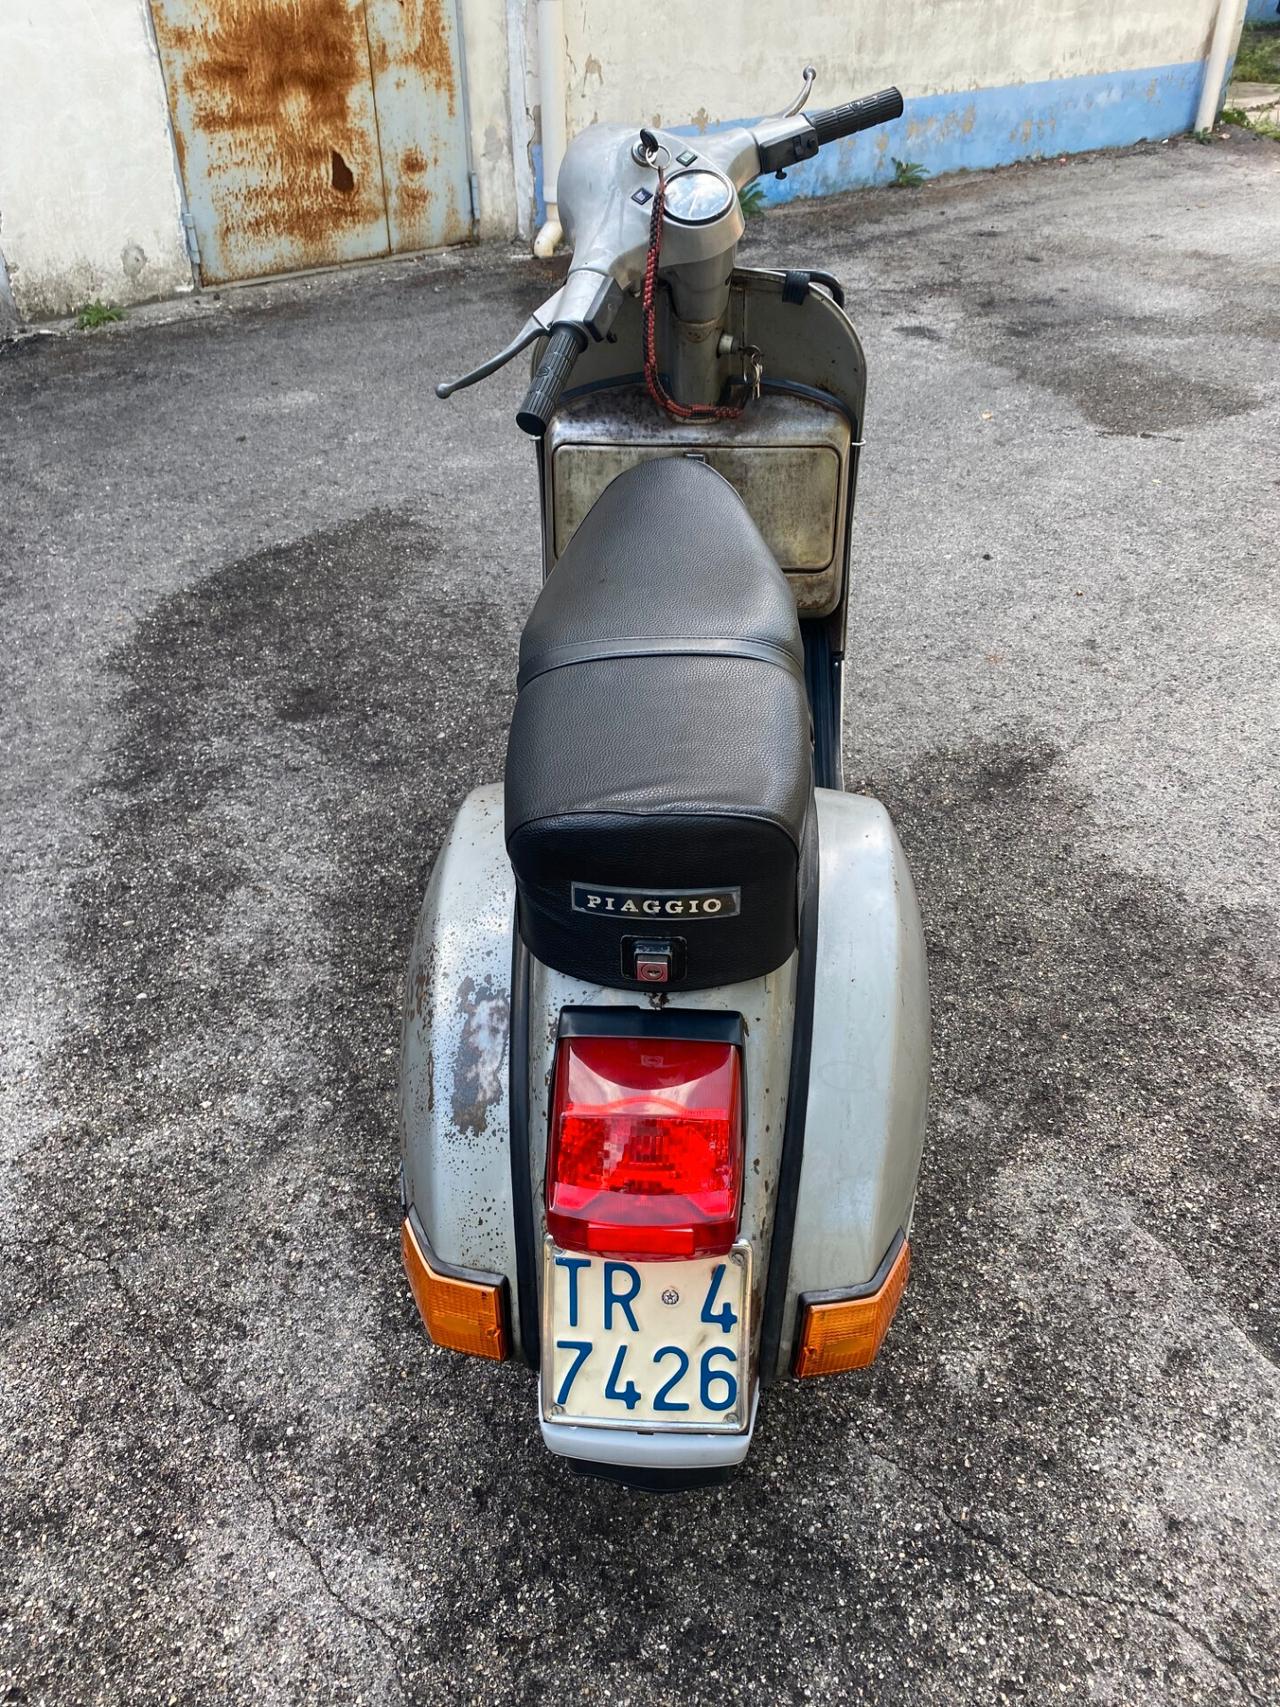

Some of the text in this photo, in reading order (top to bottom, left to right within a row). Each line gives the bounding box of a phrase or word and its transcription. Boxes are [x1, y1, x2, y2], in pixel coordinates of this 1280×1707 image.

[587, 895, 722, 914] PIAGGIO
[555, 1257, 738, 1333] TR 4
[556, 1341, 738, 1411] 7426
